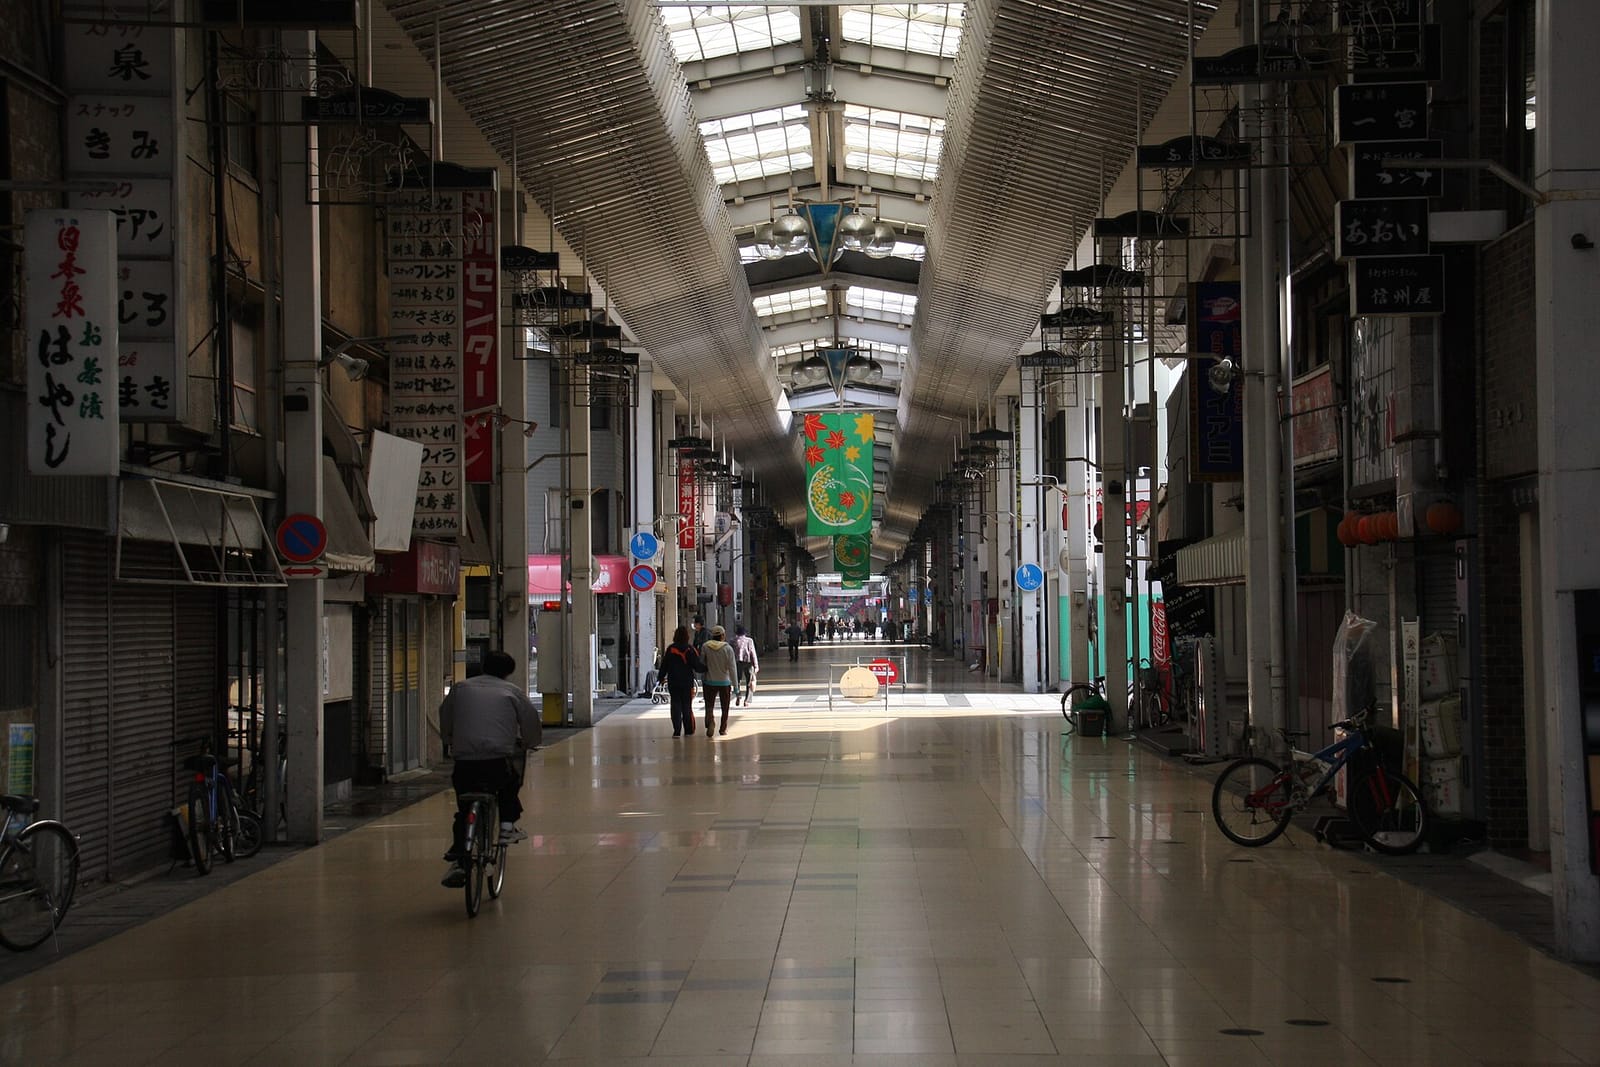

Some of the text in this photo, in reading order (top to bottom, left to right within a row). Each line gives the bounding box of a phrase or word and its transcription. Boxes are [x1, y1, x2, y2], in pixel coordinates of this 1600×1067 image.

[108, 44, 152, 81] 泉
[78, 104, 135, 117] スナック
[85, 128, 159, 159] きみ
[1345, 218, 1420, 245] あおい
[51, 226, 87, 319] 日本泉
[421, 287, 455, 301] おぐり
[1370, 285, 1433, 305] 信州屋
[77, 321, 105, 420] お茶漬
[414, 355, 456, 370] ほなみ
[39, 325, 74, 469] はやし
